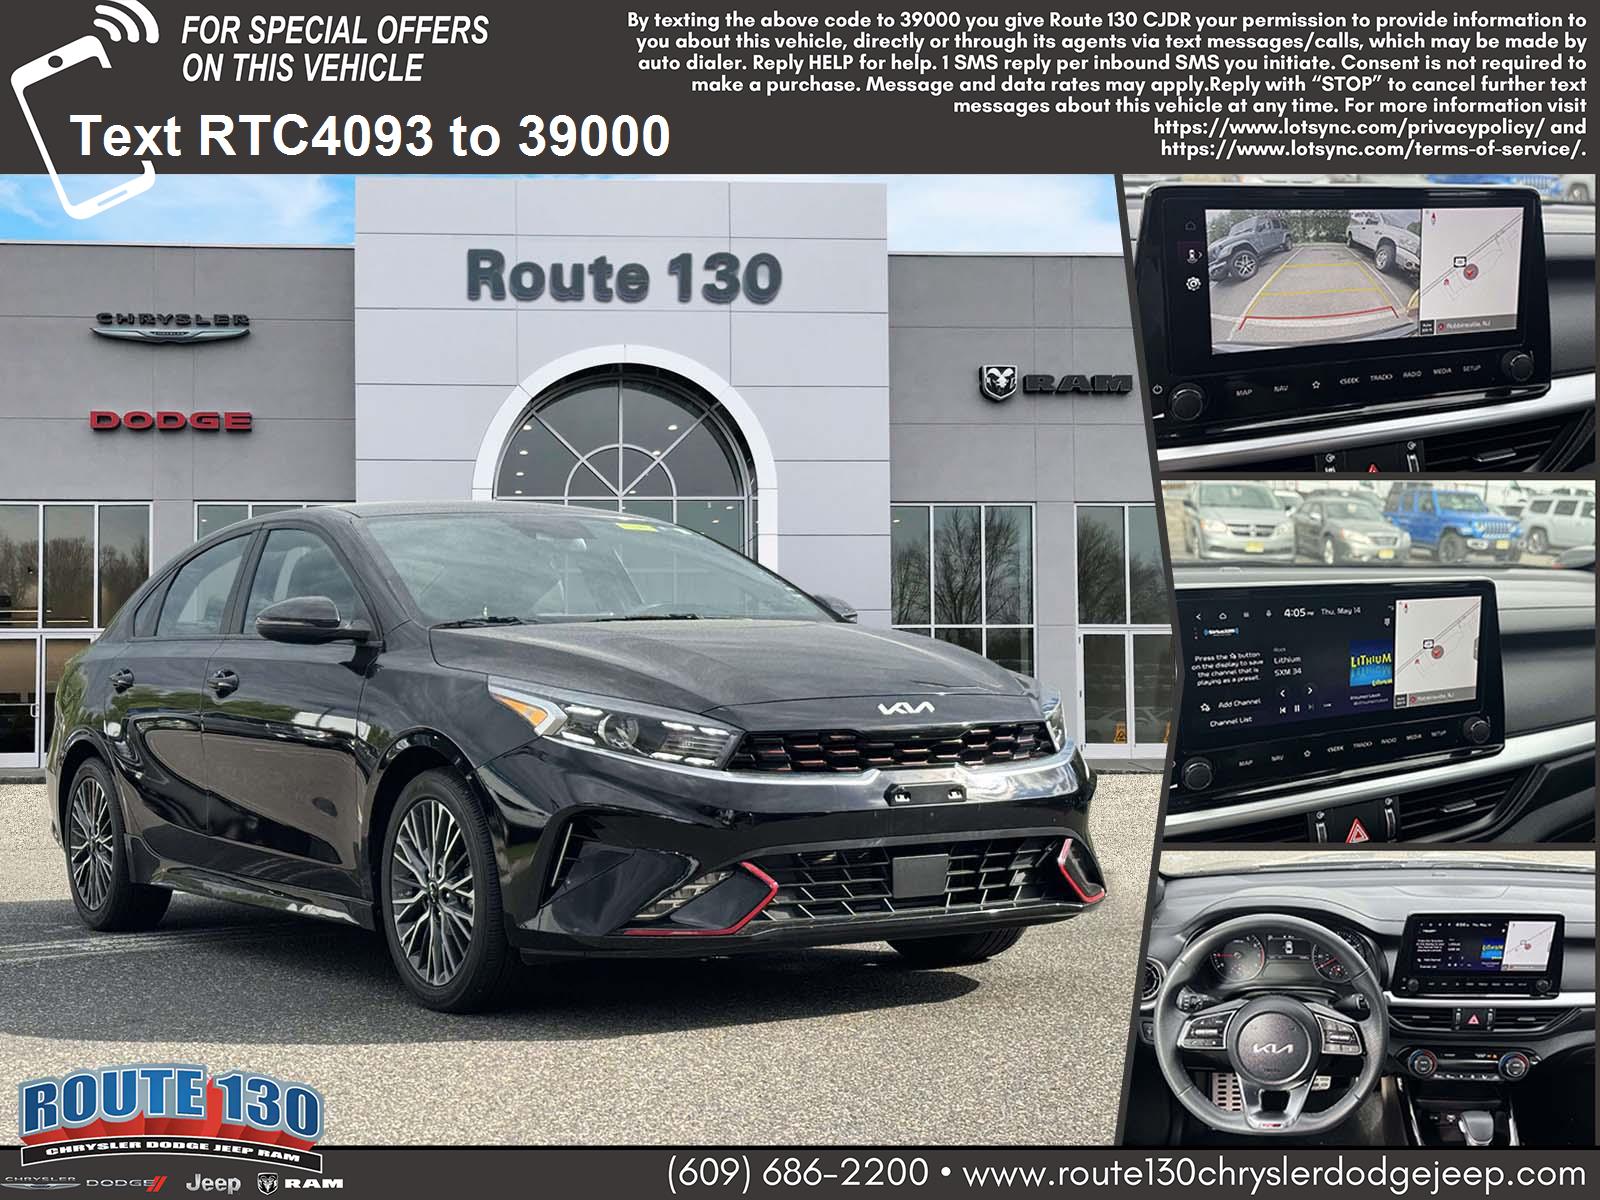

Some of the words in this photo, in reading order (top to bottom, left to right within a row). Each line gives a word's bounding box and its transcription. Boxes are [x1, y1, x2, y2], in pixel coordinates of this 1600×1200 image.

[467, 248, 650, 303] Route
[668, 252, 783, 305] 130
[96, 312, 250, 326] CHRYSLER
[1433, 367, 1452, 375] MEDIA
[1463, 364, 1481, 372] SETUP
[1023, 374, 1133, 395] RAM
[89, 410, 251, 432] DODGE
[1284, 608, 1306, 617] 4:05
[1337, 607, 1352, 616] May
[1215, 661, 1239, 669] display
[1273, 656, 1302, 664] Lithium
[1211, 669, 1237, 677] channel
[1274, 668, 1291, 677] SXM
[1293, 667, 1302, 675] 34
[1197, 678, 1222, 686] playing
[1233, 698, 1261, 707] Channel
[1209, 718, 1238, 727] Channel
